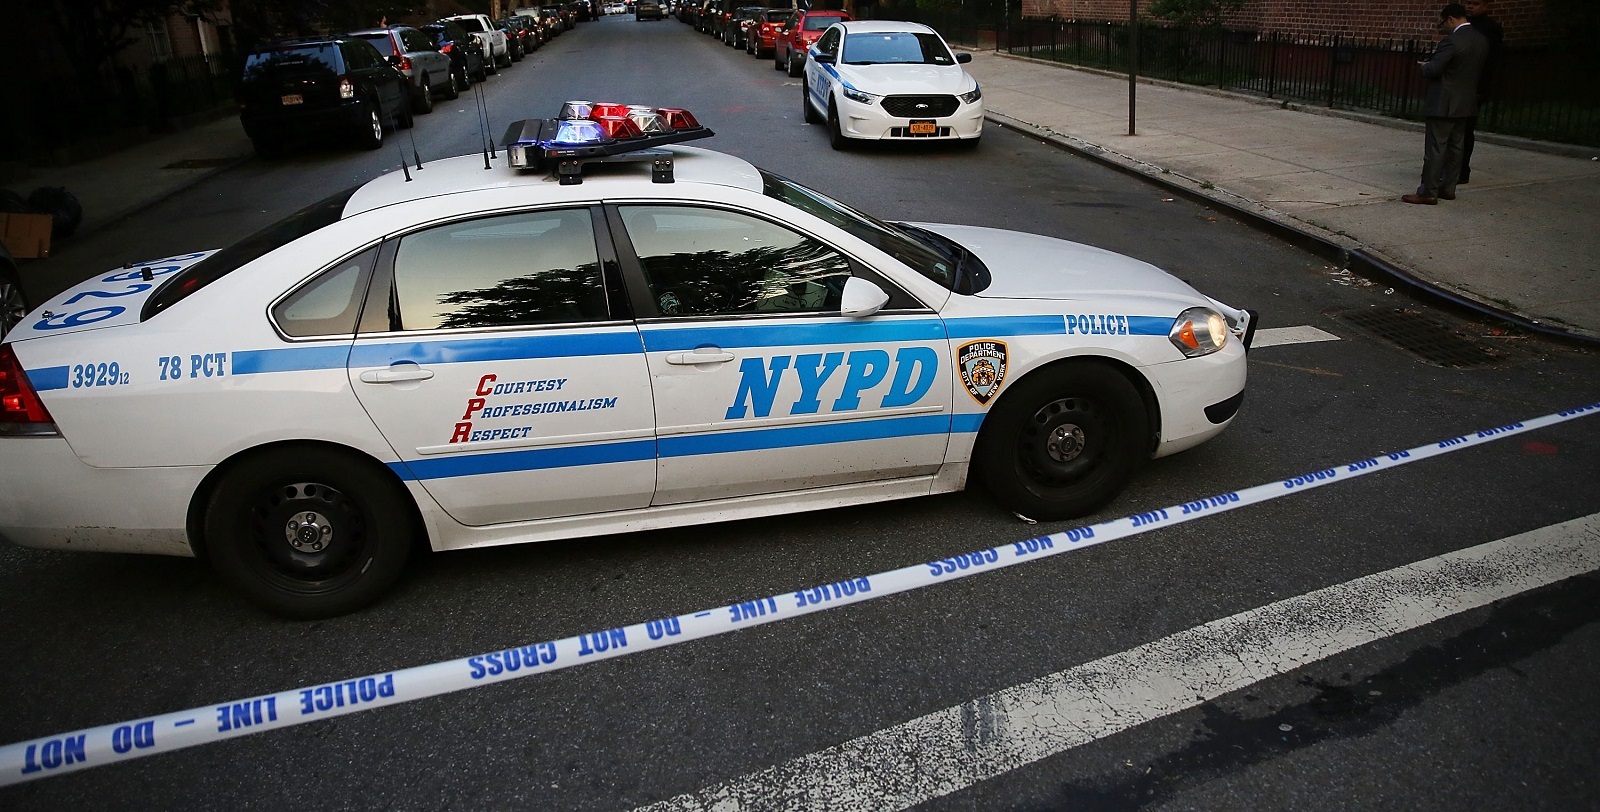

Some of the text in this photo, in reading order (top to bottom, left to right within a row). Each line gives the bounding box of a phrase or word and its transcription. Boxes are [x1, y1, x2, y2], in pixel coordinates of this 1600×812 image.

[1066, 314, 1127, 336] POLICE
[961, 350, 1005, 364] DEPARTMENT
[969, 342, 996, 352] POLICE
[158, 355, 182, 381] 78
[190, 352, 227, 378] PCT
[962, 371, 972, 386] CITY
[988, 363, 1006, 397] NEW YORK
[475, 373, 568, 397] COURTESY
[725, 347, 938, 420] NYPD
[462, 397, 618, 420] PROFESSIONALISM
[449, 421, 533, 444] RESPECT
[578, 627, 628, 657] NOT
[645, 616, 682, 641] DO
[468, 641, 557, 680] CROSS
[299, 673, 395, 715] POLICE
[216, 695, 278, 733] LINE
[111, 720, 155, 754] DO
[21, 734, 87, 775] NOT
